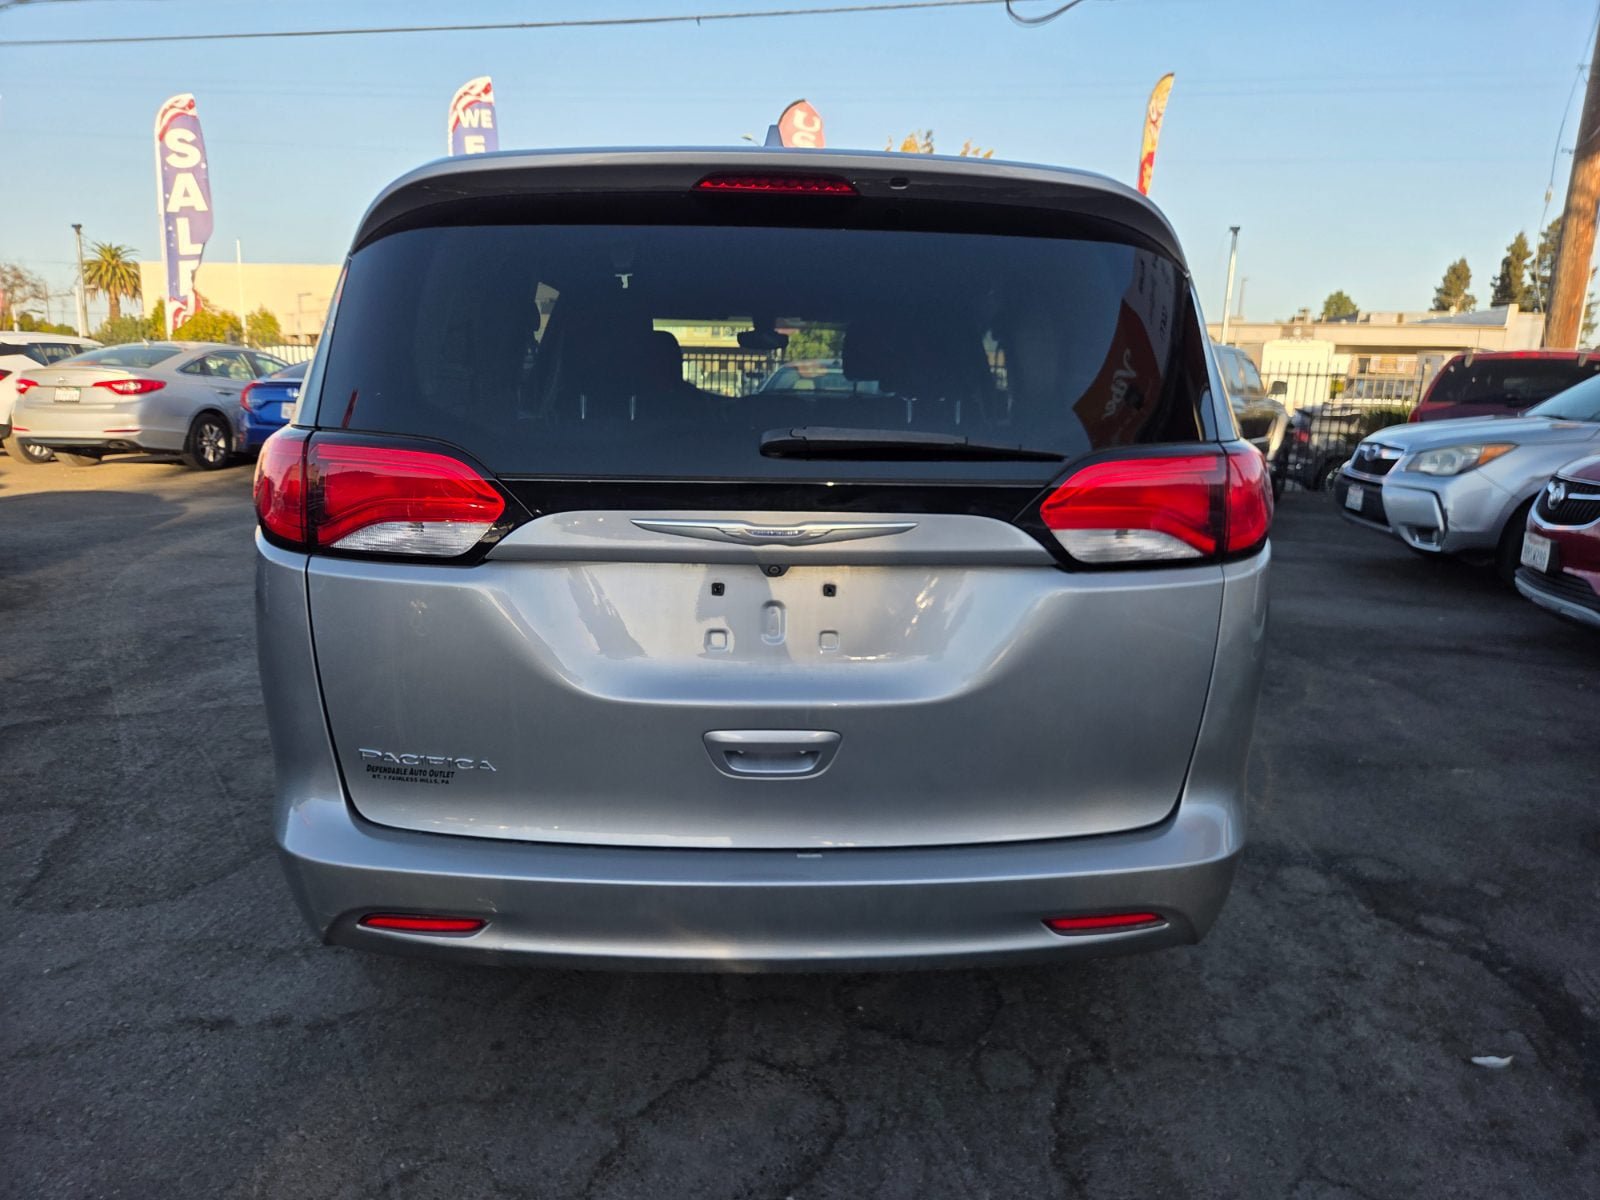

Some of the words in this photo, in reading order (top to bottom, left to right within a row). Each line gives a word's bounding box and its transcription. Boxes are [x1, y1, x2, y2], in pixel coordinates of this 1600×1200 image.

[459, 107, 494, 129] WE
[358, 747, 497, 772] PACIFICA
[409, 767, 427, 777] AUTO
[428, 769, 456, 779] OUTLET
